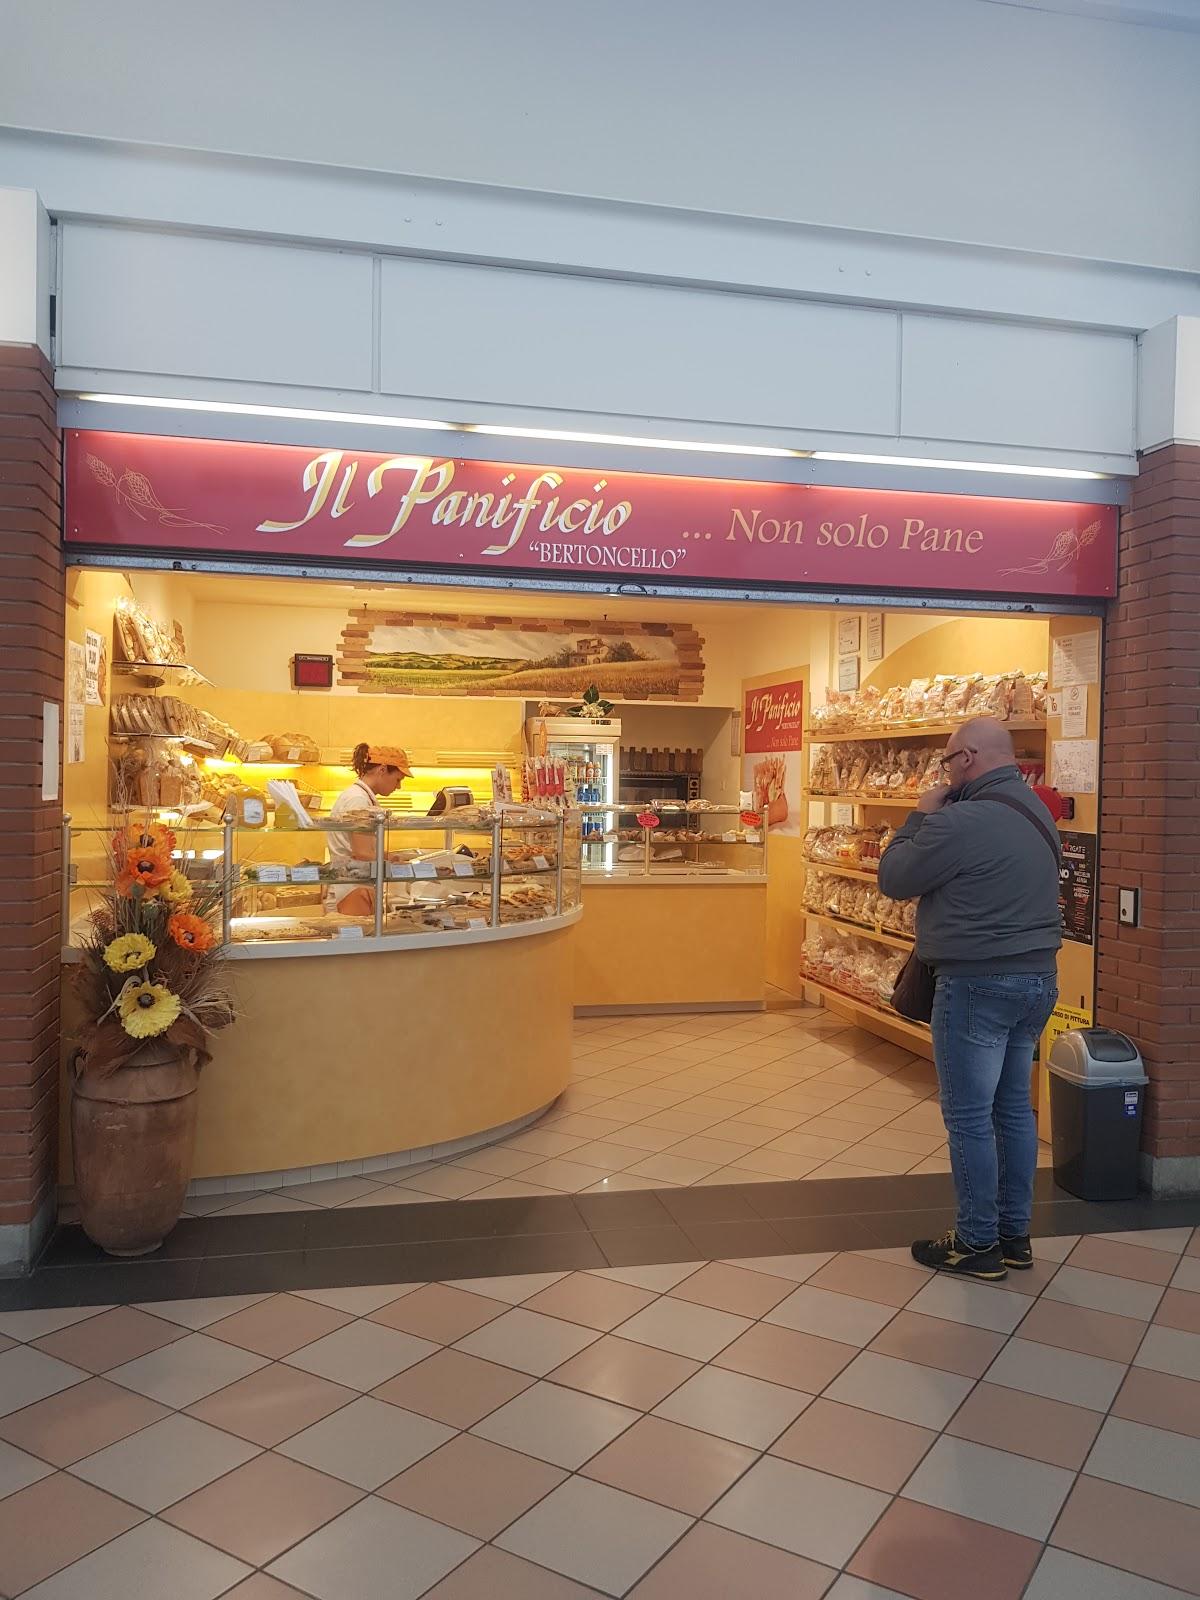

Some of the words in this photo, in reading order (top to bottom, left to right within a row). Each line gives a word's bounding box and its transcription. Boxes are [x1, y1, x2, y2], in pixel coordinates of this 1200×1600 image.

[256, 451, 358, 532] Il
[344, 457, 632, 555] Panificio
[726, 508, 804, 544] Non
[816, 513, 889, 549] solo
[899, 517, 984, 553] Pane
[756, 692, 801, 732] Panificio
[1070, 1015, 1090, 1025] PITTURA
